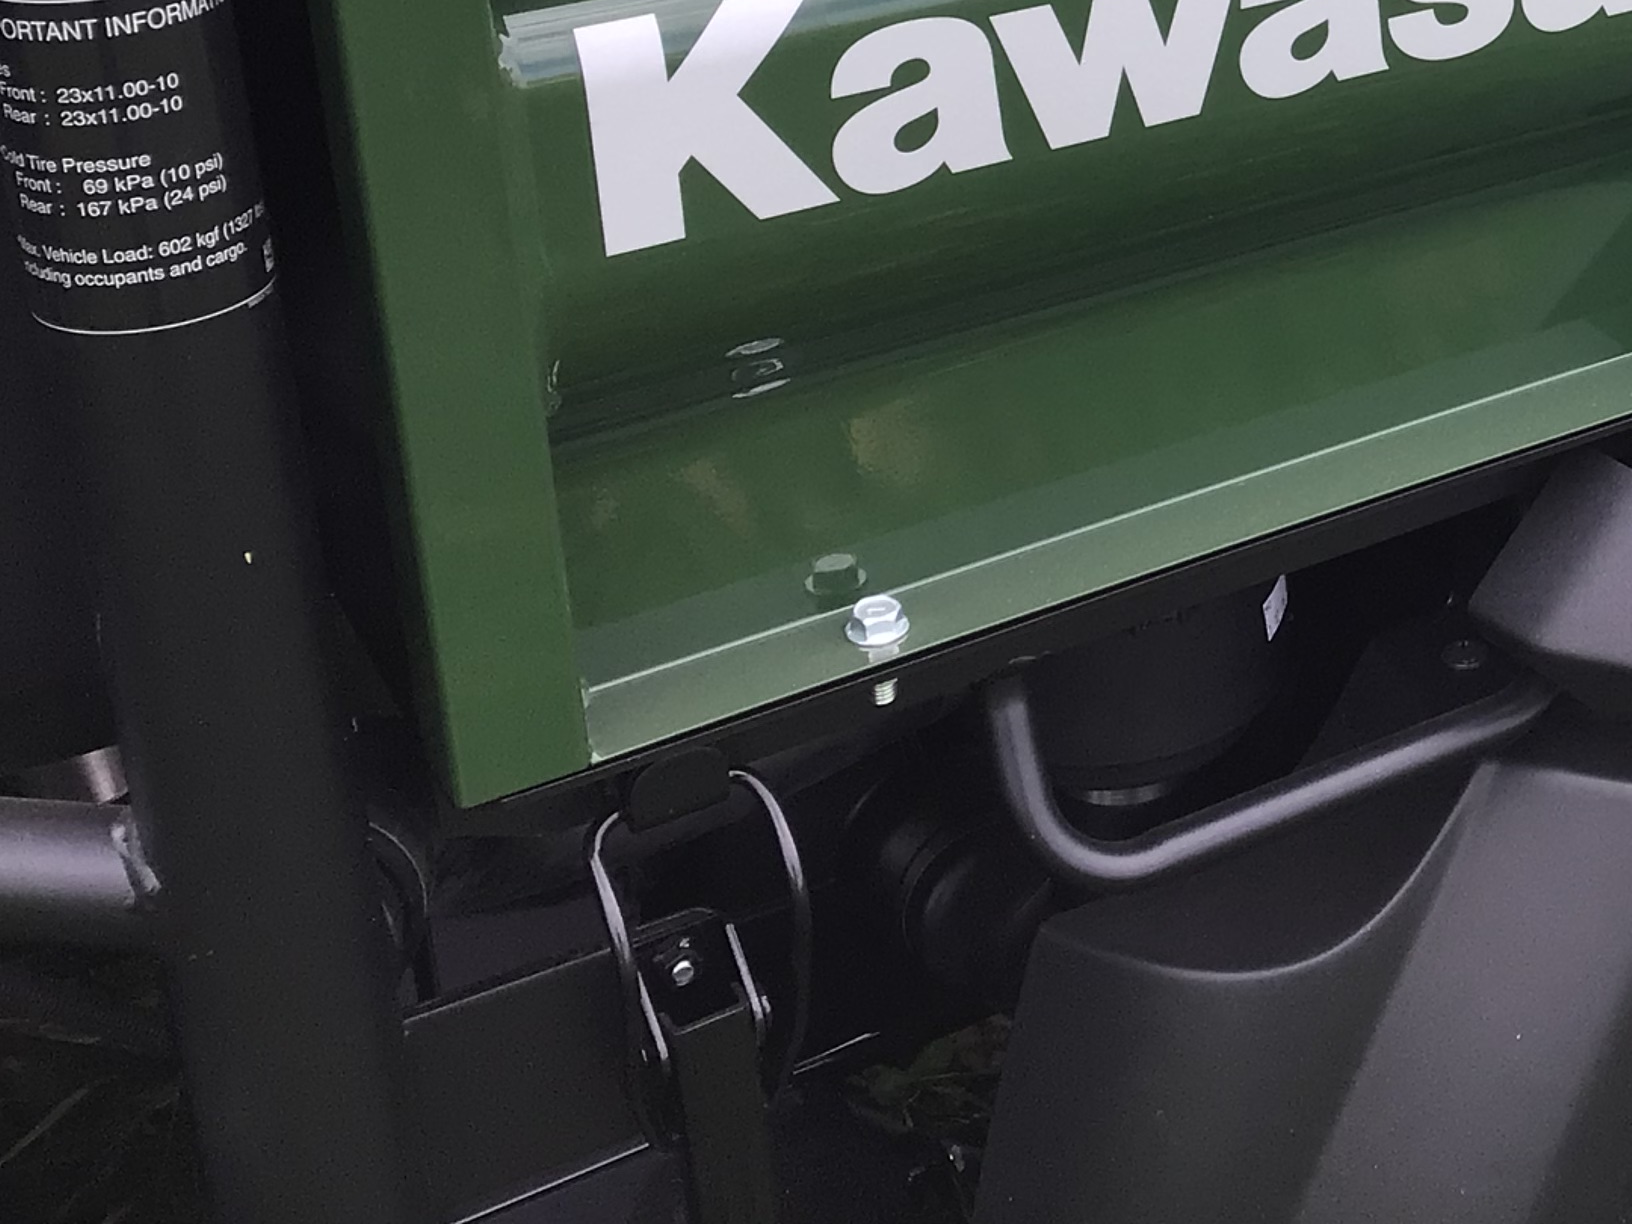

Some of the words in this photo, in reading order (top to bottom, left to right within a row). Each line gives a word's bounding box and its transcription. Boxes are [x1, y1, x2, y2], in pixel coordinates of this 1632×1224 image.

[56, 73, 179, 104] 23x11.00-10
[3, 103, 37, 124] Rear
[60, 95, 183, 127] 23x11.00-10
[15, 171, 52, 193] Front
[83, 178, 108, 194] 69
[114, 174, 154, 192] kPa
[160, 164, 191, 188] (10
[195, 152, 223, 178] psi)
[26, 153, 57, 173] Tire
[62, 153, 151, 173] Pressure
[19, 193, 52, 214] Rear
[77, 200, 112, 217] 167
[118, 197, 158, 215] kPa
[163, 186, 194, 210] (24
[198, 174, 227, 201] psi)
[42, 244, 97, 264] Vehicle
[102, 244, 153, 264] Load:
[158, 236, 193, 257] 602
[196, 225, 220, 248] kgf
[74, 269, 165, 289] occupants
[170, 256, 203, 278] and
[206, 241, 248, 268] cargo.
